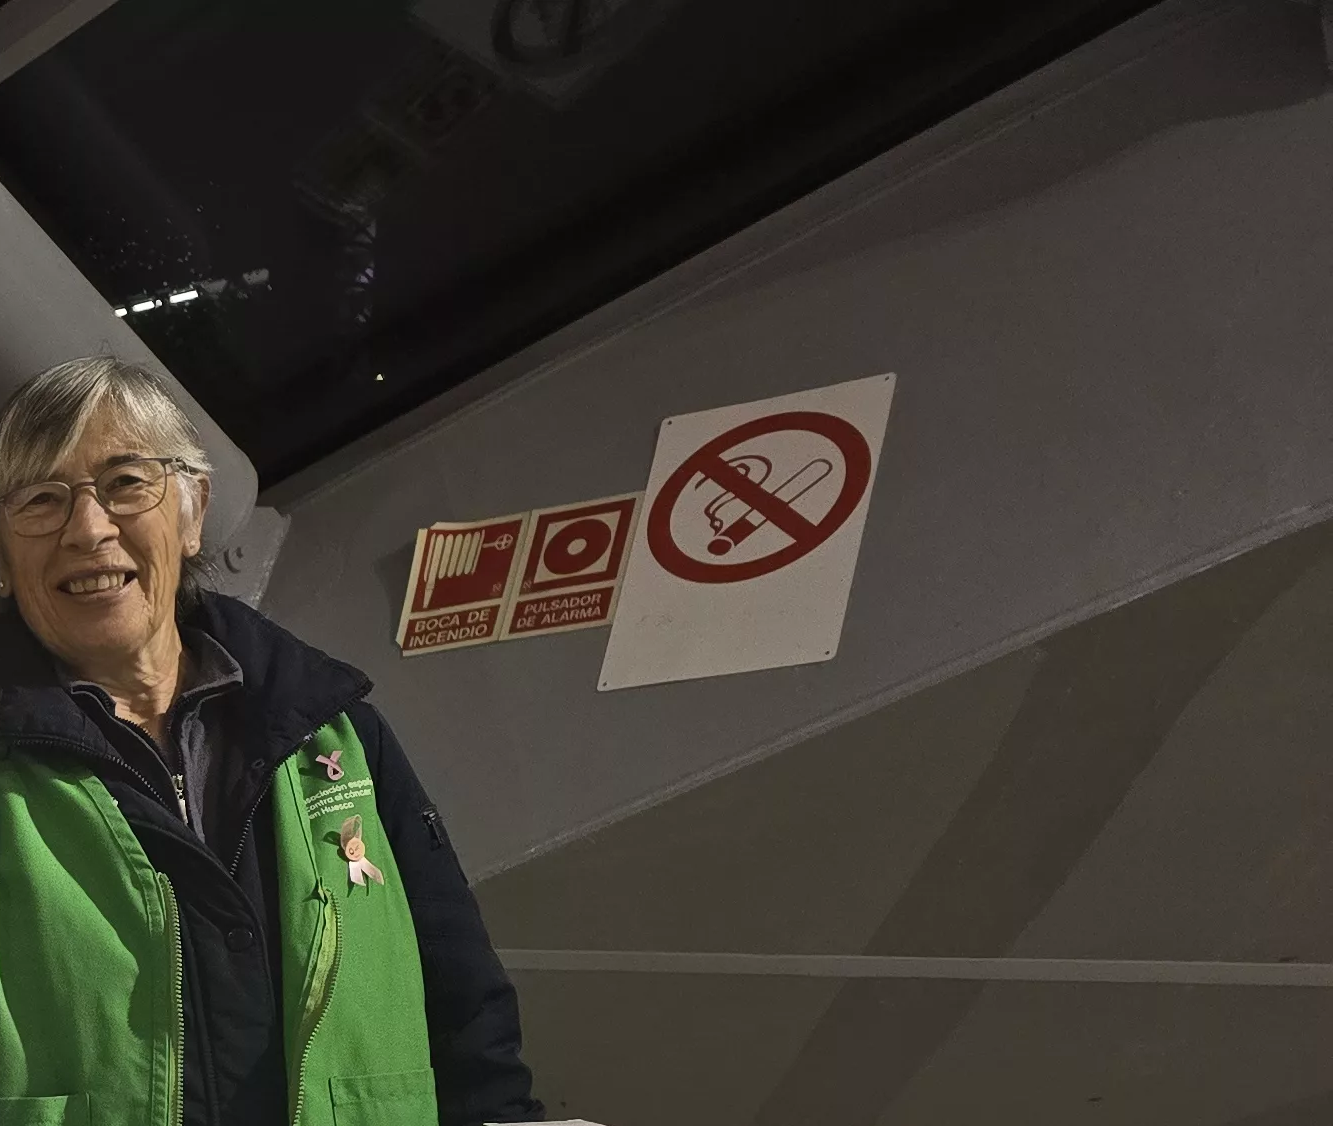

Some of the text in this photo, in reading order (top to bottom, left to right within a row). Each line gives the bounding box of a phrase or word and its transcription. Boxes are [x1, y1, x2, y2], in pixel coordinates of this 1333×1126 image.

[524, 593, 602, 615] PULSADOR
[414, 608, 491, 633] BOCA DE
[517, 608, 601, 629] DE ALARMA
[409, 624, 488, 647] INCENDIO
[305, 784, 348, 804] sociación
[321, 801, 355, 815] Huesca
